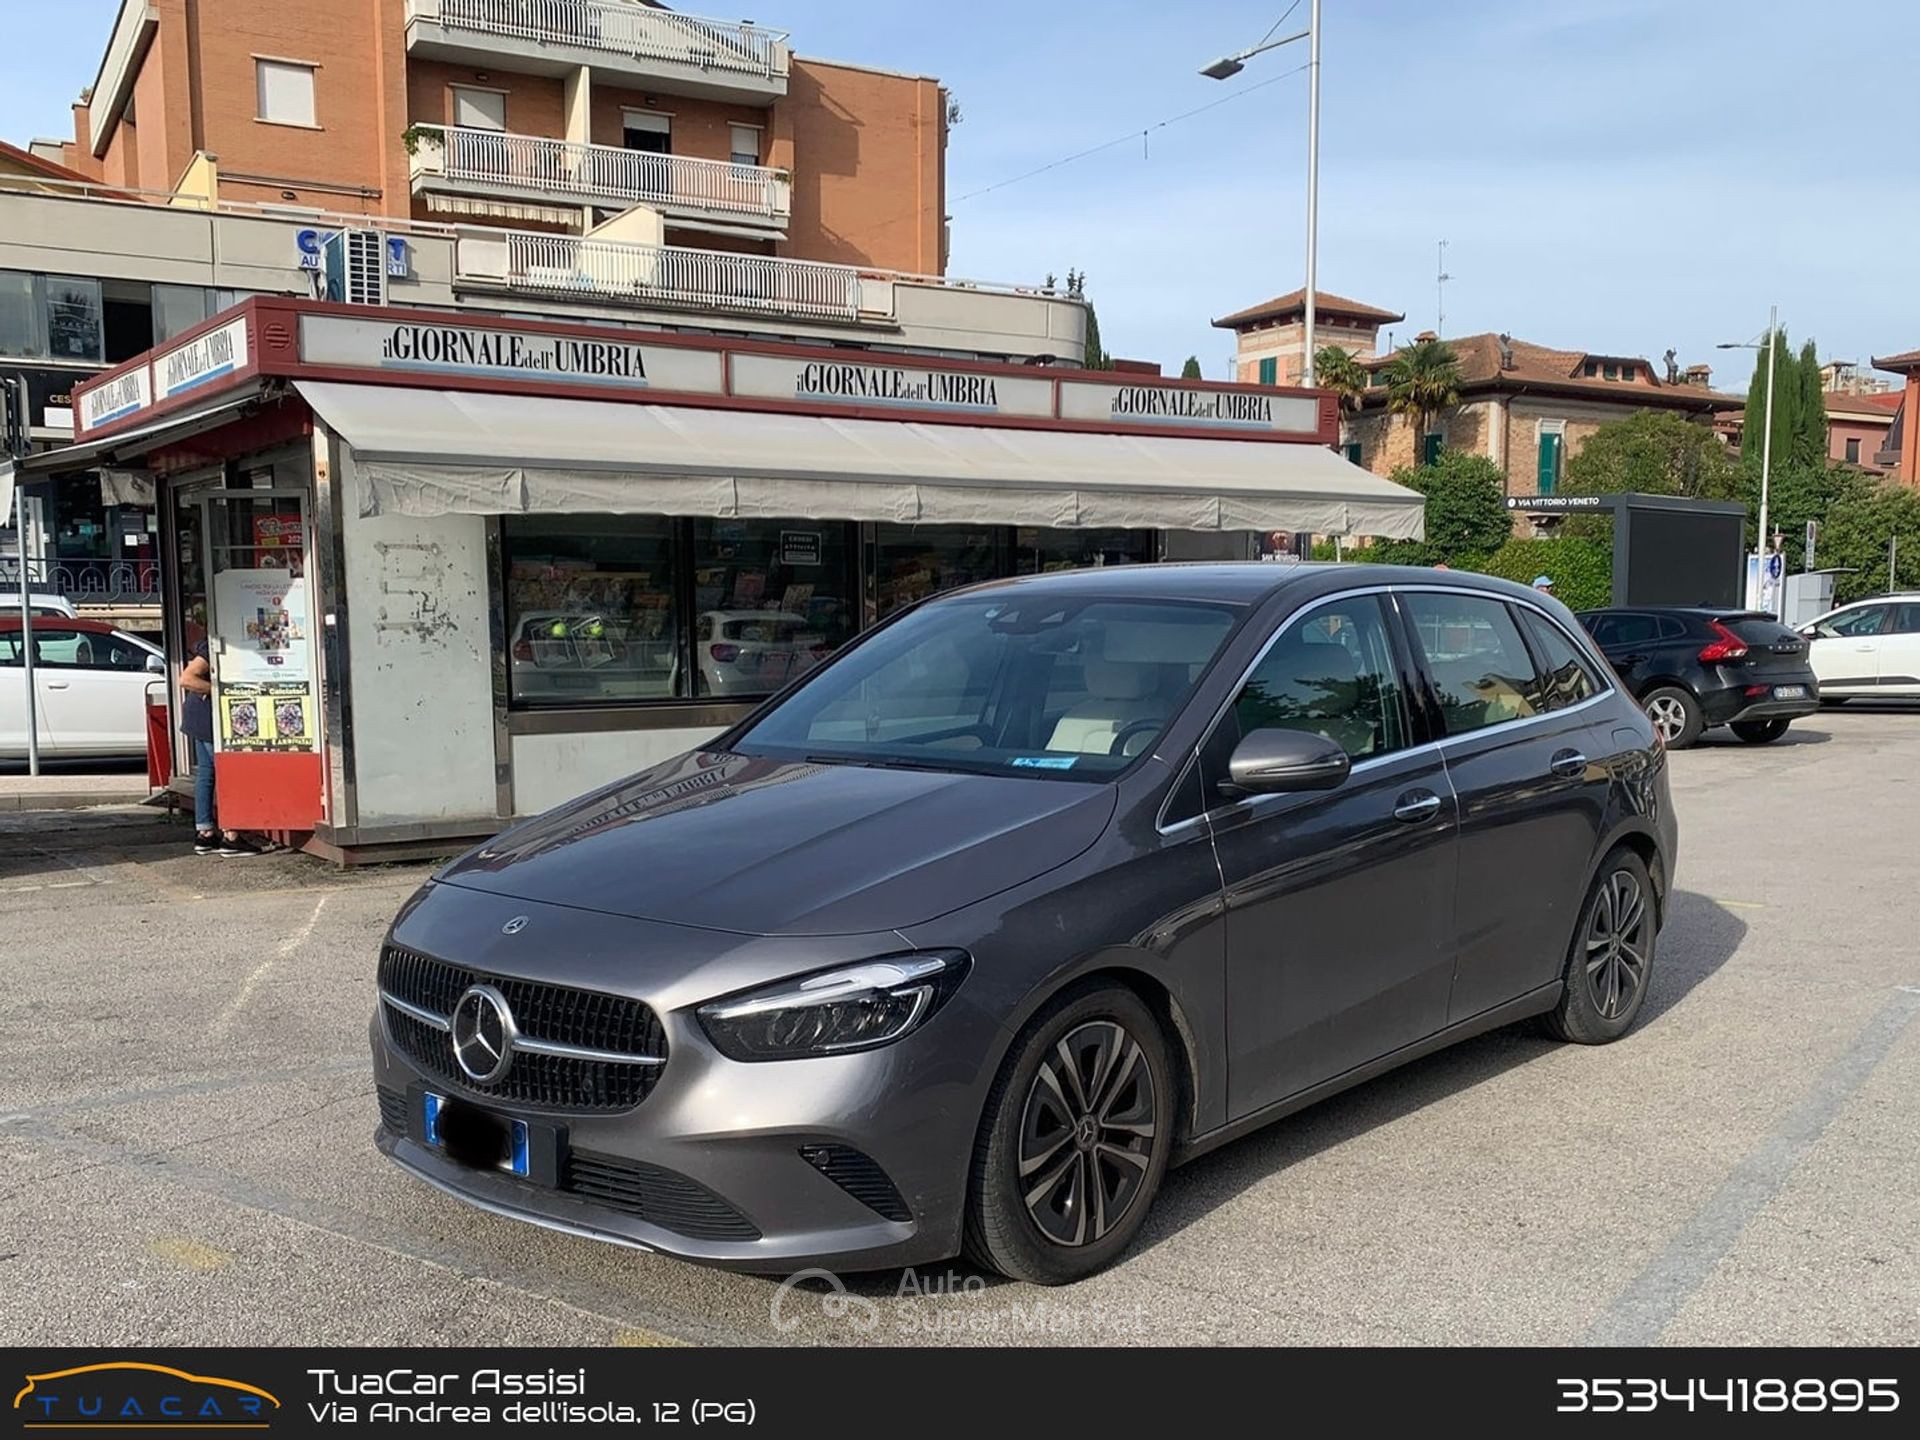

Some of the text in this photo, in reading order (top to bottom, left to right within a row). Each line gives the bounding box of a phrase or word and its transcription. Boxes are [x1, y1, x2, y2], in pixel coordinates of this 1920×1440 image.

[49, 394, 73, 404] CES
[1518, 497, 1600, 507] VIA VITTORIO VENETO
